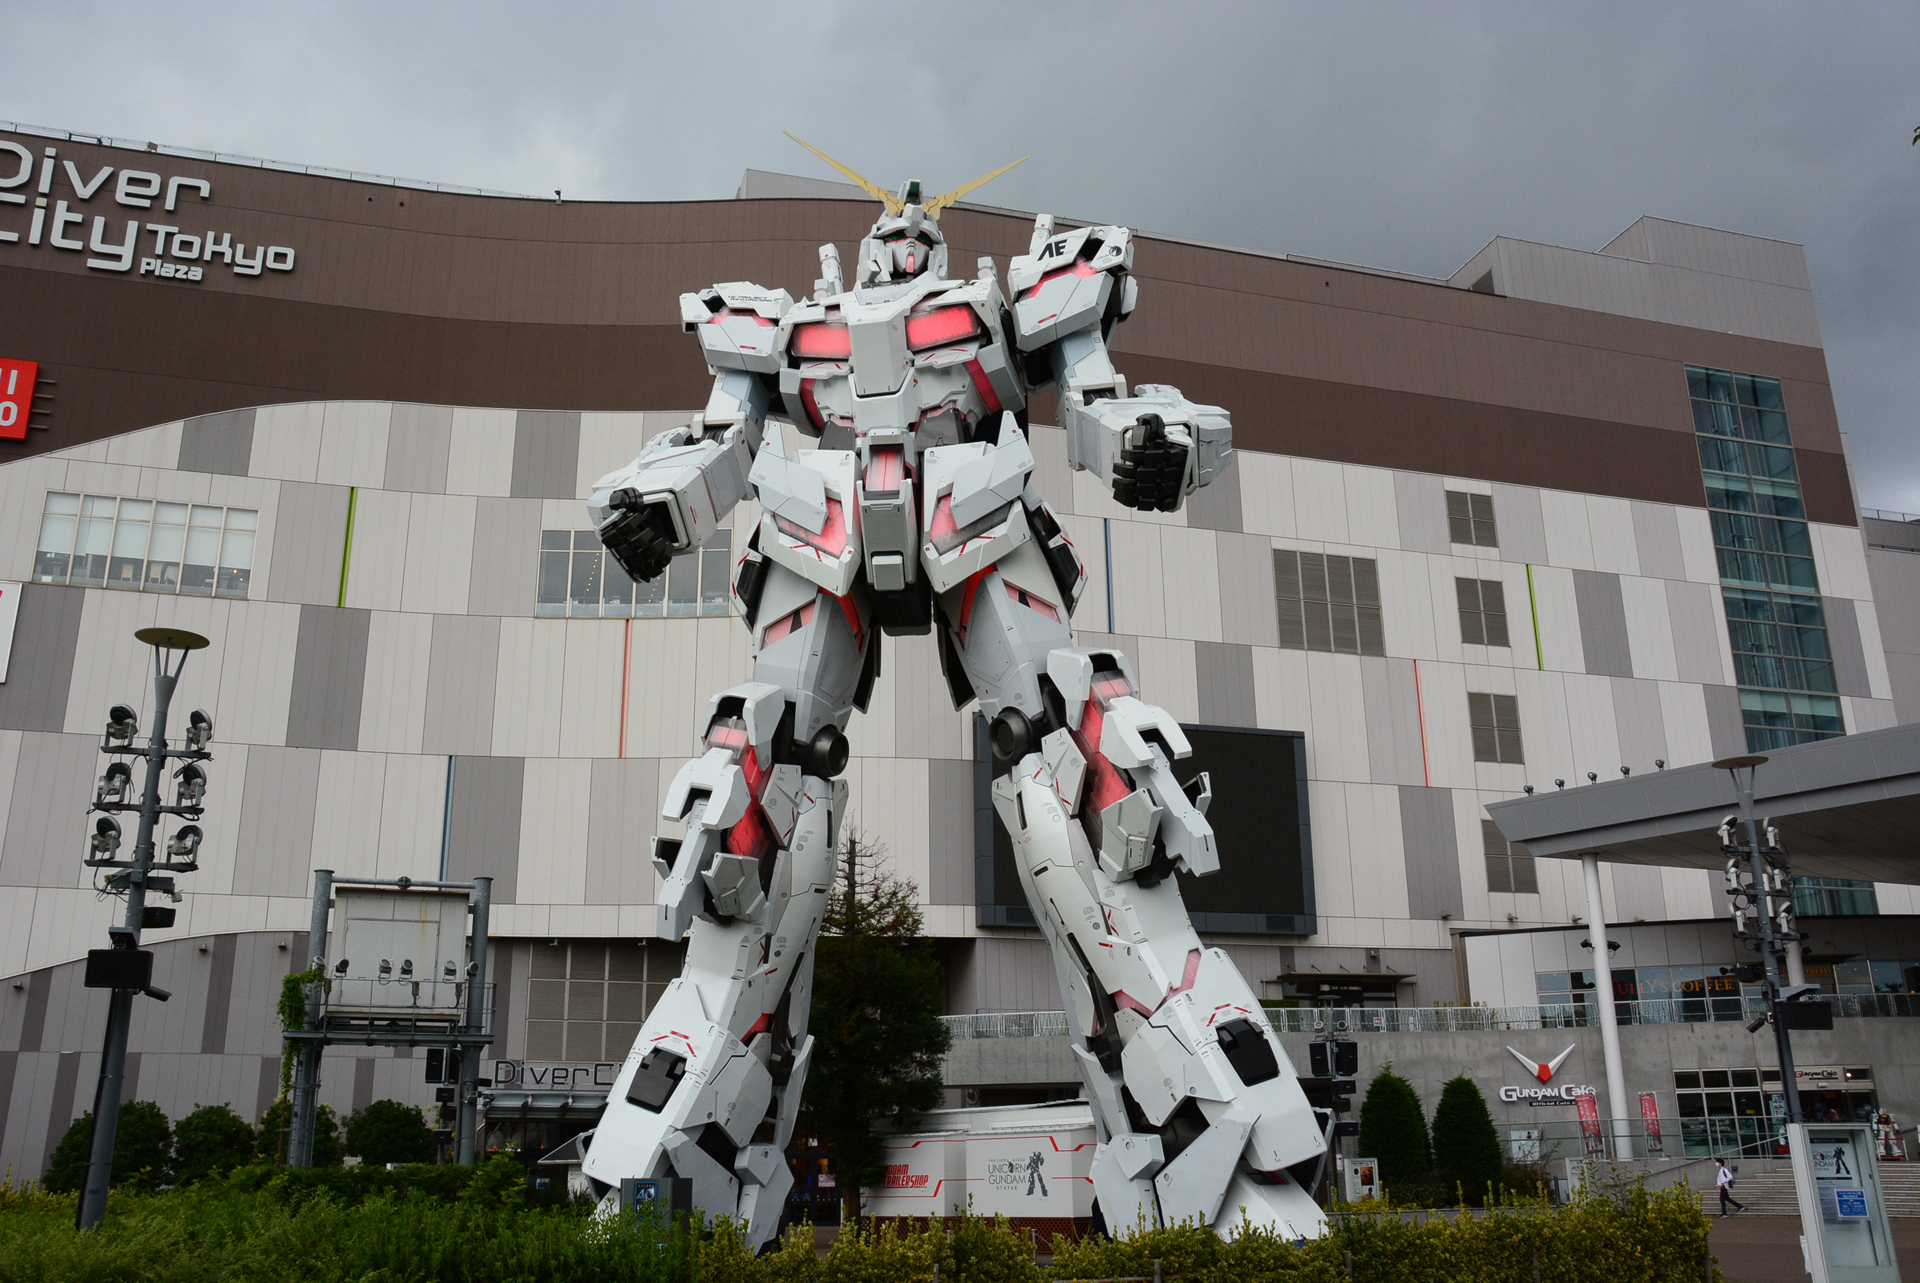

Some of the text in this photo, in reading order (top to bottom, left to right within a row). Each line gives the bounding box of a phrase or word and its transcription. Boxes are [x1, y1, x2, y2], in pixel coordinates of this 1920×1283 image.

[139, 257, 203, 281] Plaza
[1672, 978, 1736, 992] COFFEE
[1499, 1086, 1559, 1101] GUNDAM
[988, 1174, 1026, 1185] GUNDAM
